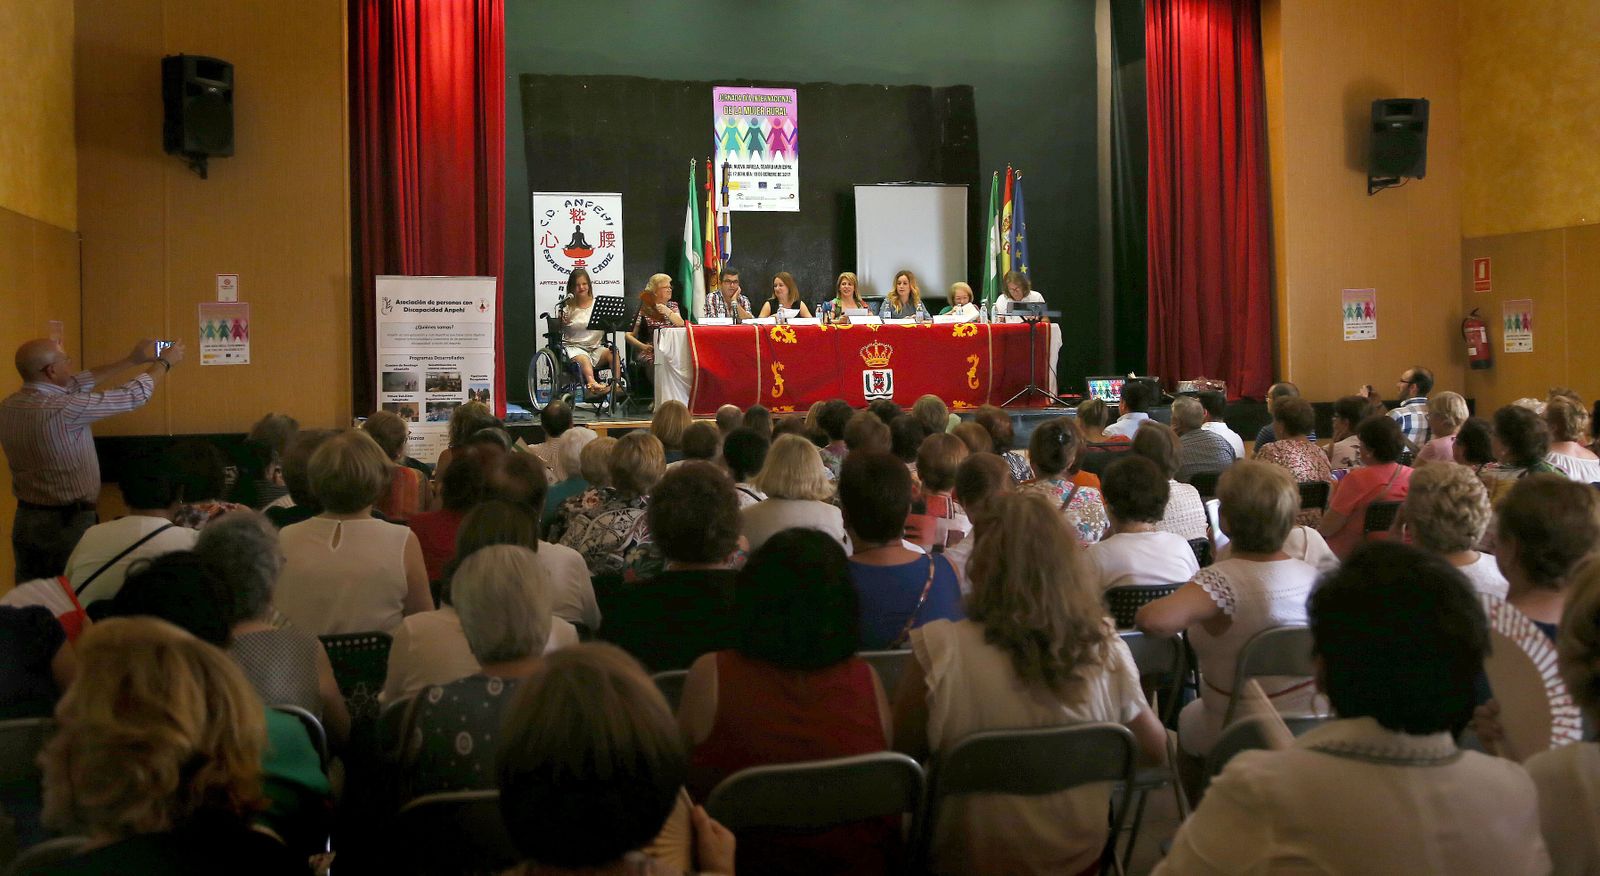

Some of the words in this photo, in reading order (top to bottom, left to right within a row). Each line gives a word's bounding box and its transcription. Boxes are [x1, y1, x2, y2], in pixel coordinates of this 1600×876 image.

[723, 105, 732, 115] DE
[734, 106, 742, 115] LA
[744, 106, 764, 116] MUJER
[766, 106, 787, 116] RURAL
[540, 230, 560, 249] 心
